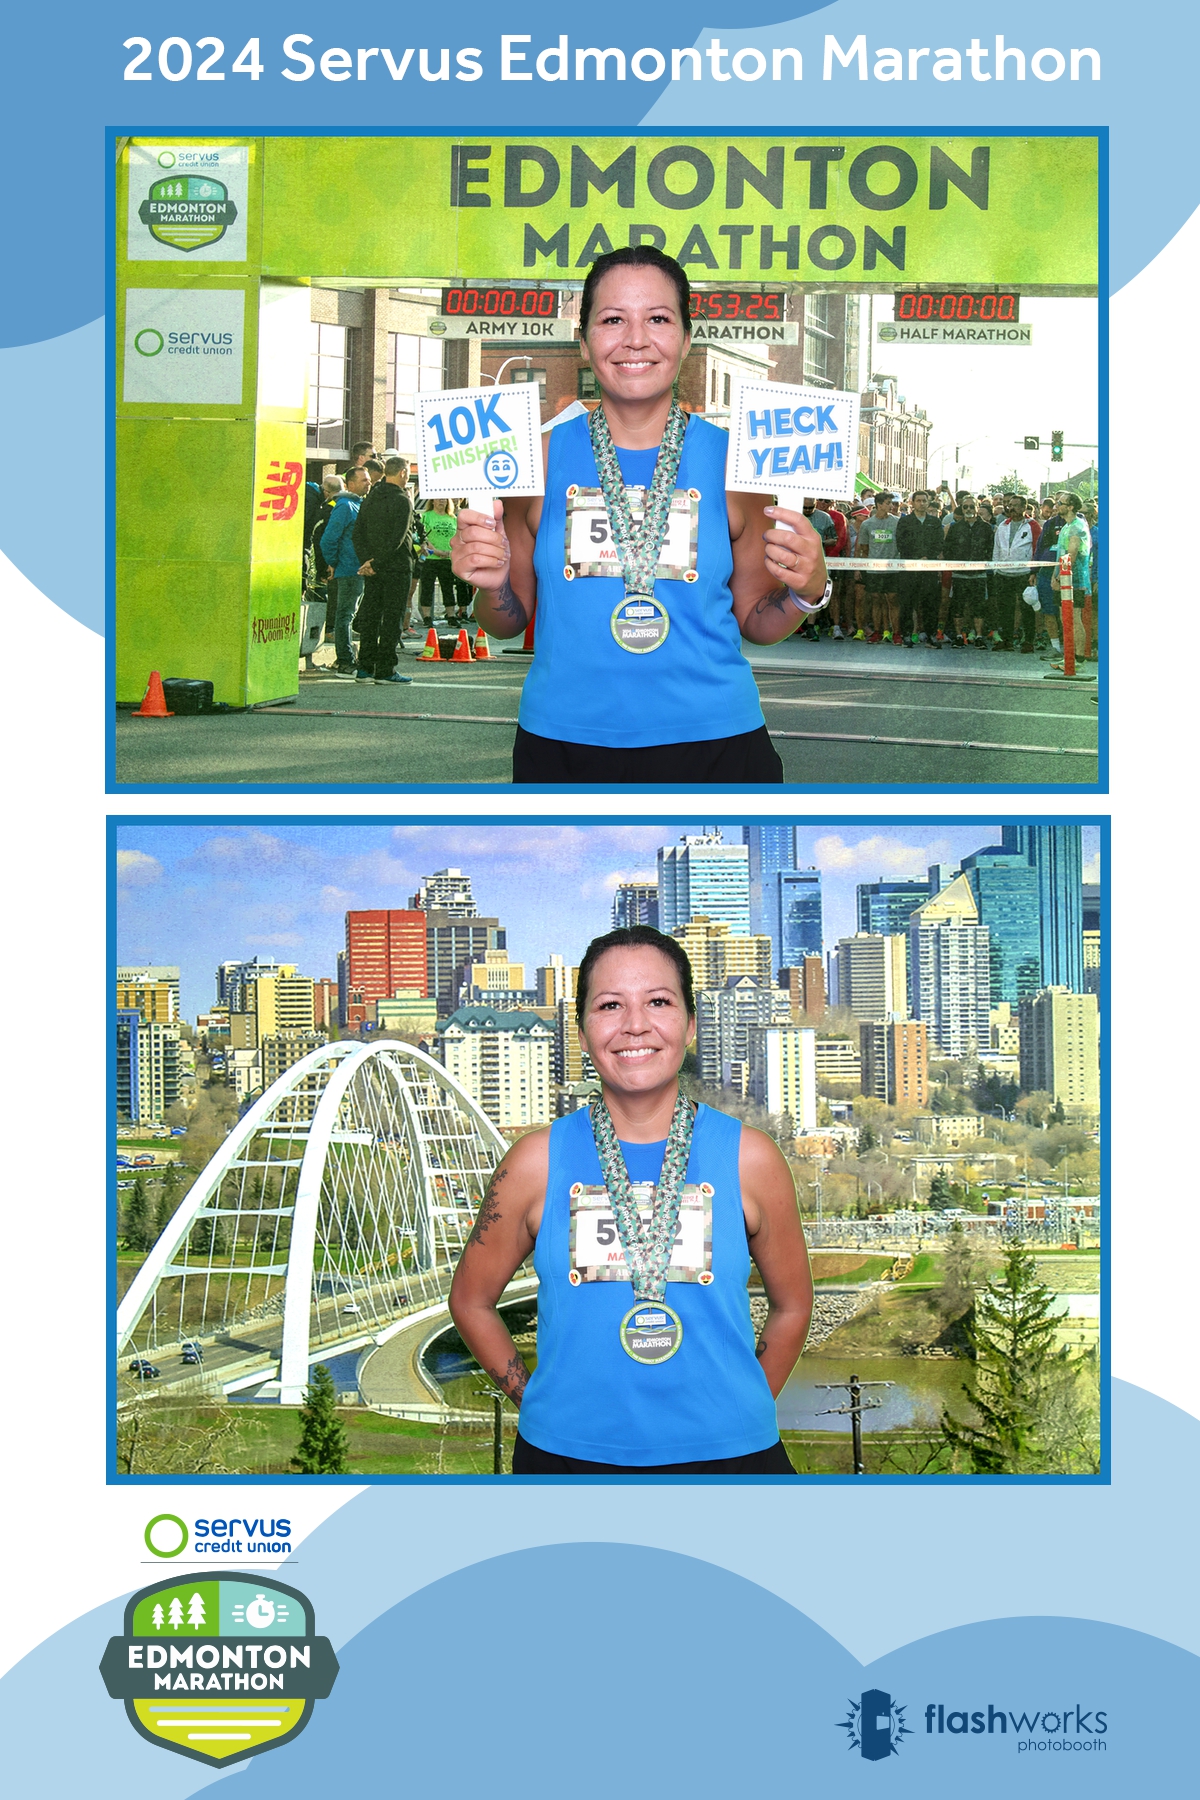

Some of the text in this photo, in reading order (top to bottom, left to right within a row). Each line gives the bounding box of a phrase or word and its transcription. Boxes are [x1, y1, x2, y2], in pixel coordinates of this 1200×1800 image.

[178, 152, 220, 161] servus
[450, 144, 990, 211] EDMONTON
[149, 202, 227, 214] EDMONTON
[160, 214, 216, 222] MARATHON
[466, 321, 554, 336] ARMY 10K
[693, 325, 785, 340] ARATHON
[900, 328, 1031, 341] HALF MARATHON
[168, 332, 233, 345] servus
[168, 345, 232, 355] credit union
[427, 392, 512, 452] 10K
[746, 404, 838, 440] HECK
[432, 435, 518, 473] FINISHER!
[748, 442, 843, 479] YEAH!
[257, 614, 291, 640] Running
[632, 1340, 672, 1348] MARATHON
